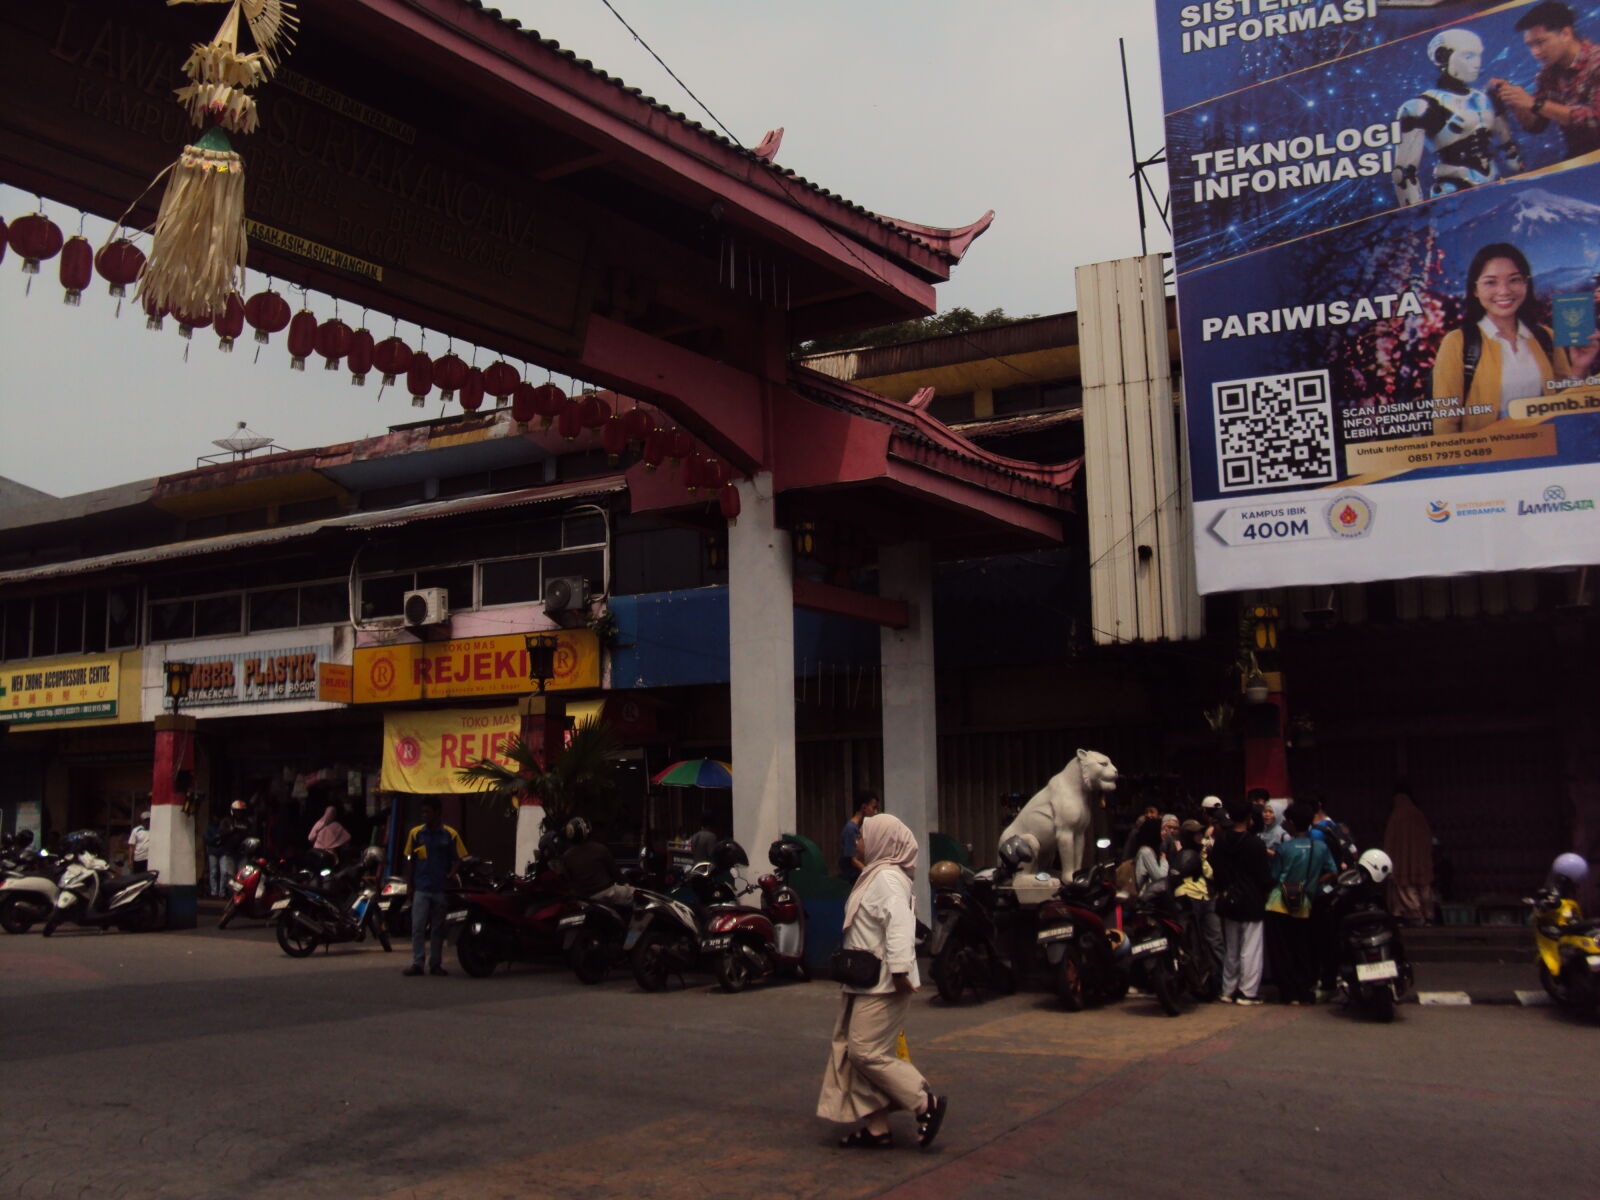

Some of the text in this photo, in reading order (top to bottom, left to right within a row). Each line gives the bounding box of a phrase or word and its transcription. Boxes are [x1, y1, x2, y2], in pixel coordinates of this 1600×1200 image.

[1181, 0, 1378, 54] INFORMASI
[50, 2, 538, 253] LAWA SURYAKANCANA
[1191, 121, 1401, 176] TEKNOLOGI
[1194, 150, 1393, 203] INFORMASI
[1202, 291, 1424, 342] PARIWISATA
[1546, 379, 1585, 390] Daftar
[1342, 397, 1459, 418] SCAN DISINI UNTUK
[1343, 404, 1493, 429] INFO PENDAFTARAN IBIK
[1344, 421, 1432, 439] LEBIH LANJUT!
[1357, 447, 1384, 456] Untuk
[1386, 440, 1428, 453] Informasi
[1430, 434, 1487, 448] Pendaftaran
[1490, 430, 1538, 442] Whatsapp
[1408, 453, 1433, 463] 0851
[1436, 450, 1462, 461] 7975
[1241, 506, 1307, 520] KAMPUS IBIK
[1517, 499, 1595, 516] LAMWISATA
[1243, 519, 1309, 540] 400M
[444, 640, 496, 652] TOKO MAS
[11, 675, 24, 692] WEN
[89, 665, 110, 684] CENTRE
[189, 653, 316, 689] MBER PLASTIK
[413, 650, 527, 685] REJEKI
[288, 681, 317, 692] BOGOR
[462, 713, 517, 729] TOKO MAS
[440, 731, 521, 768] REJE
